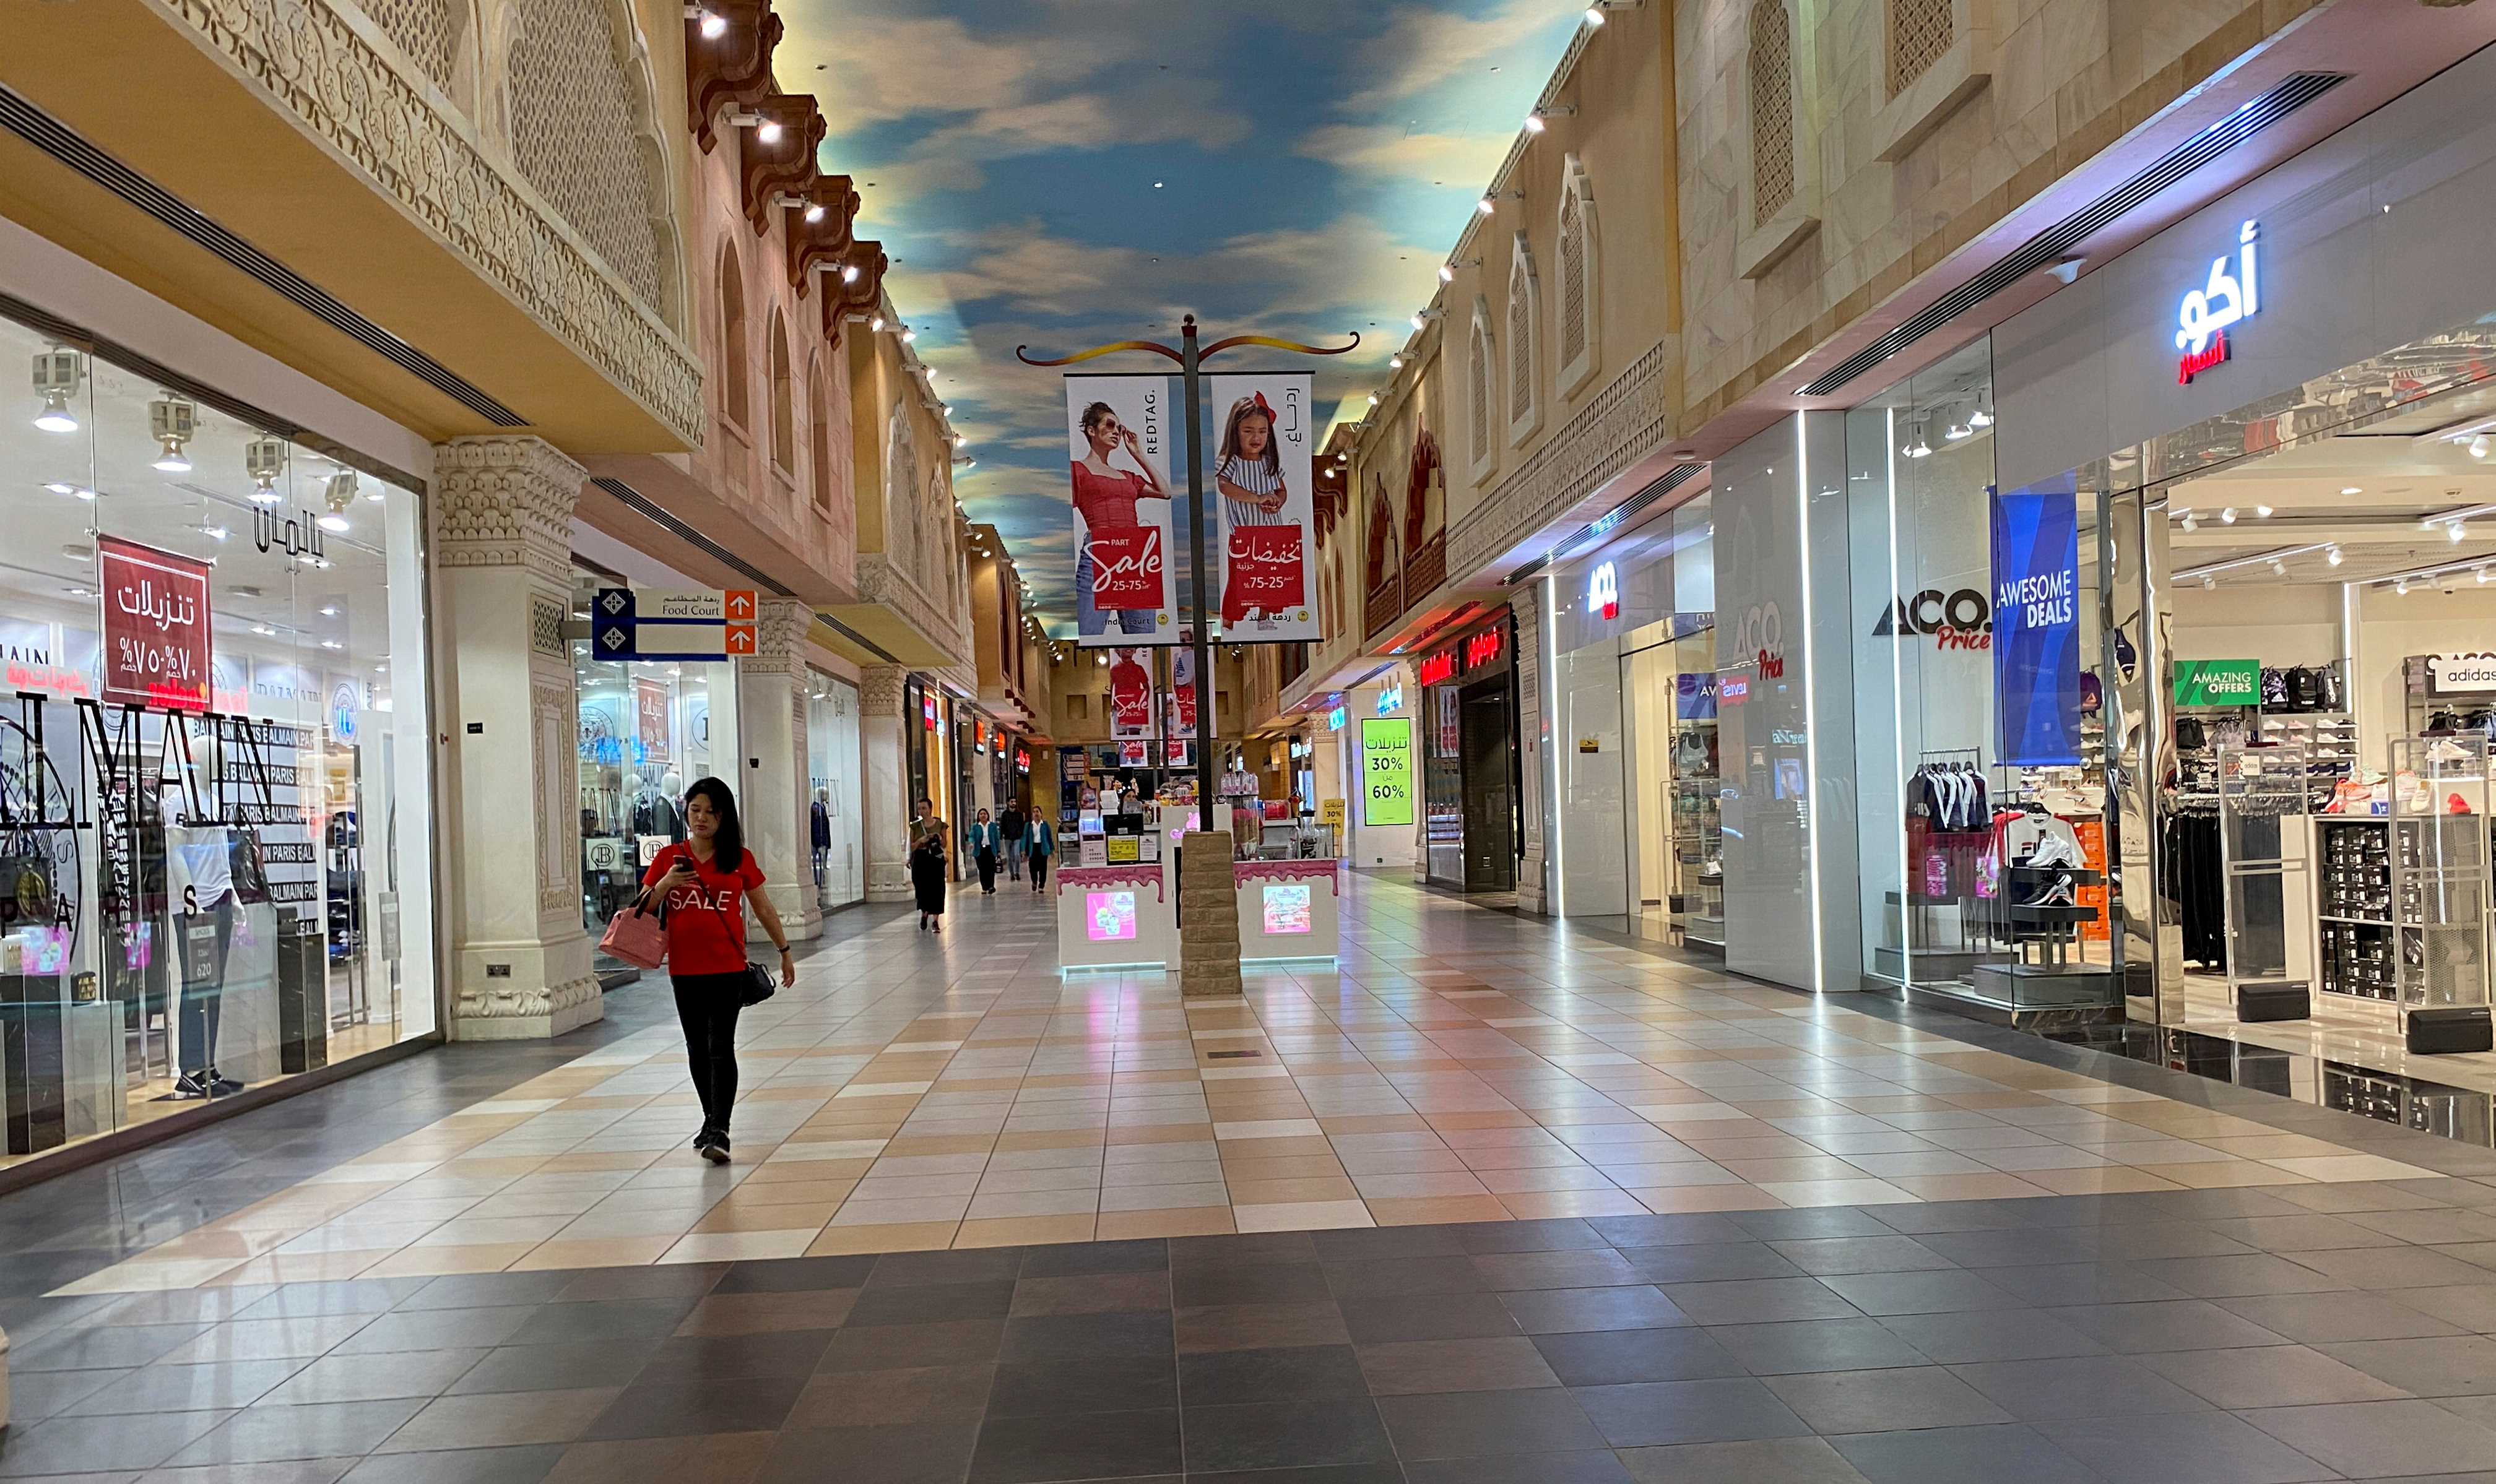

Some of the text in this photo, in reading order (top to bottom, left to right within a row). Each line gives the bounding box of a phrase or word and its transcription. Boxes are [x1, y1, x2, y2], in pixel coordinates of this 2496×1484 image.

[1084, 530, 1162, 592] Sale
[1228, 536, 1302, 571] تخفيضات
[1112, 580, 1142, 590] 25-75
[1996, 569, 2071, 609] AWESOME
[118, 579, 194, 631] تنزيلات
[662, 605, 719, 616] Food Court
[2027, 597, 2072, 629] DEALS
[1936, 625, 1991, 651] Price
[2191, 672, 2252, 684] AMAZING
[2448, 668, 2496, 682] adidas
[2208, 683, 2252, 694] OFFERS
[1114, 690, 1149, 717] Sale
[1366, 736, 1407, 753] تنزيلات
[1372, 757, 1403, 770] 30%
[271, 767, 294, 783] PARIS
[1373, 785, 1404, 799] 60%
[272, 847, 297, 861] PARIS
[669, 890, 732, 912] SALE
[197, 962, 212, 977] 620
